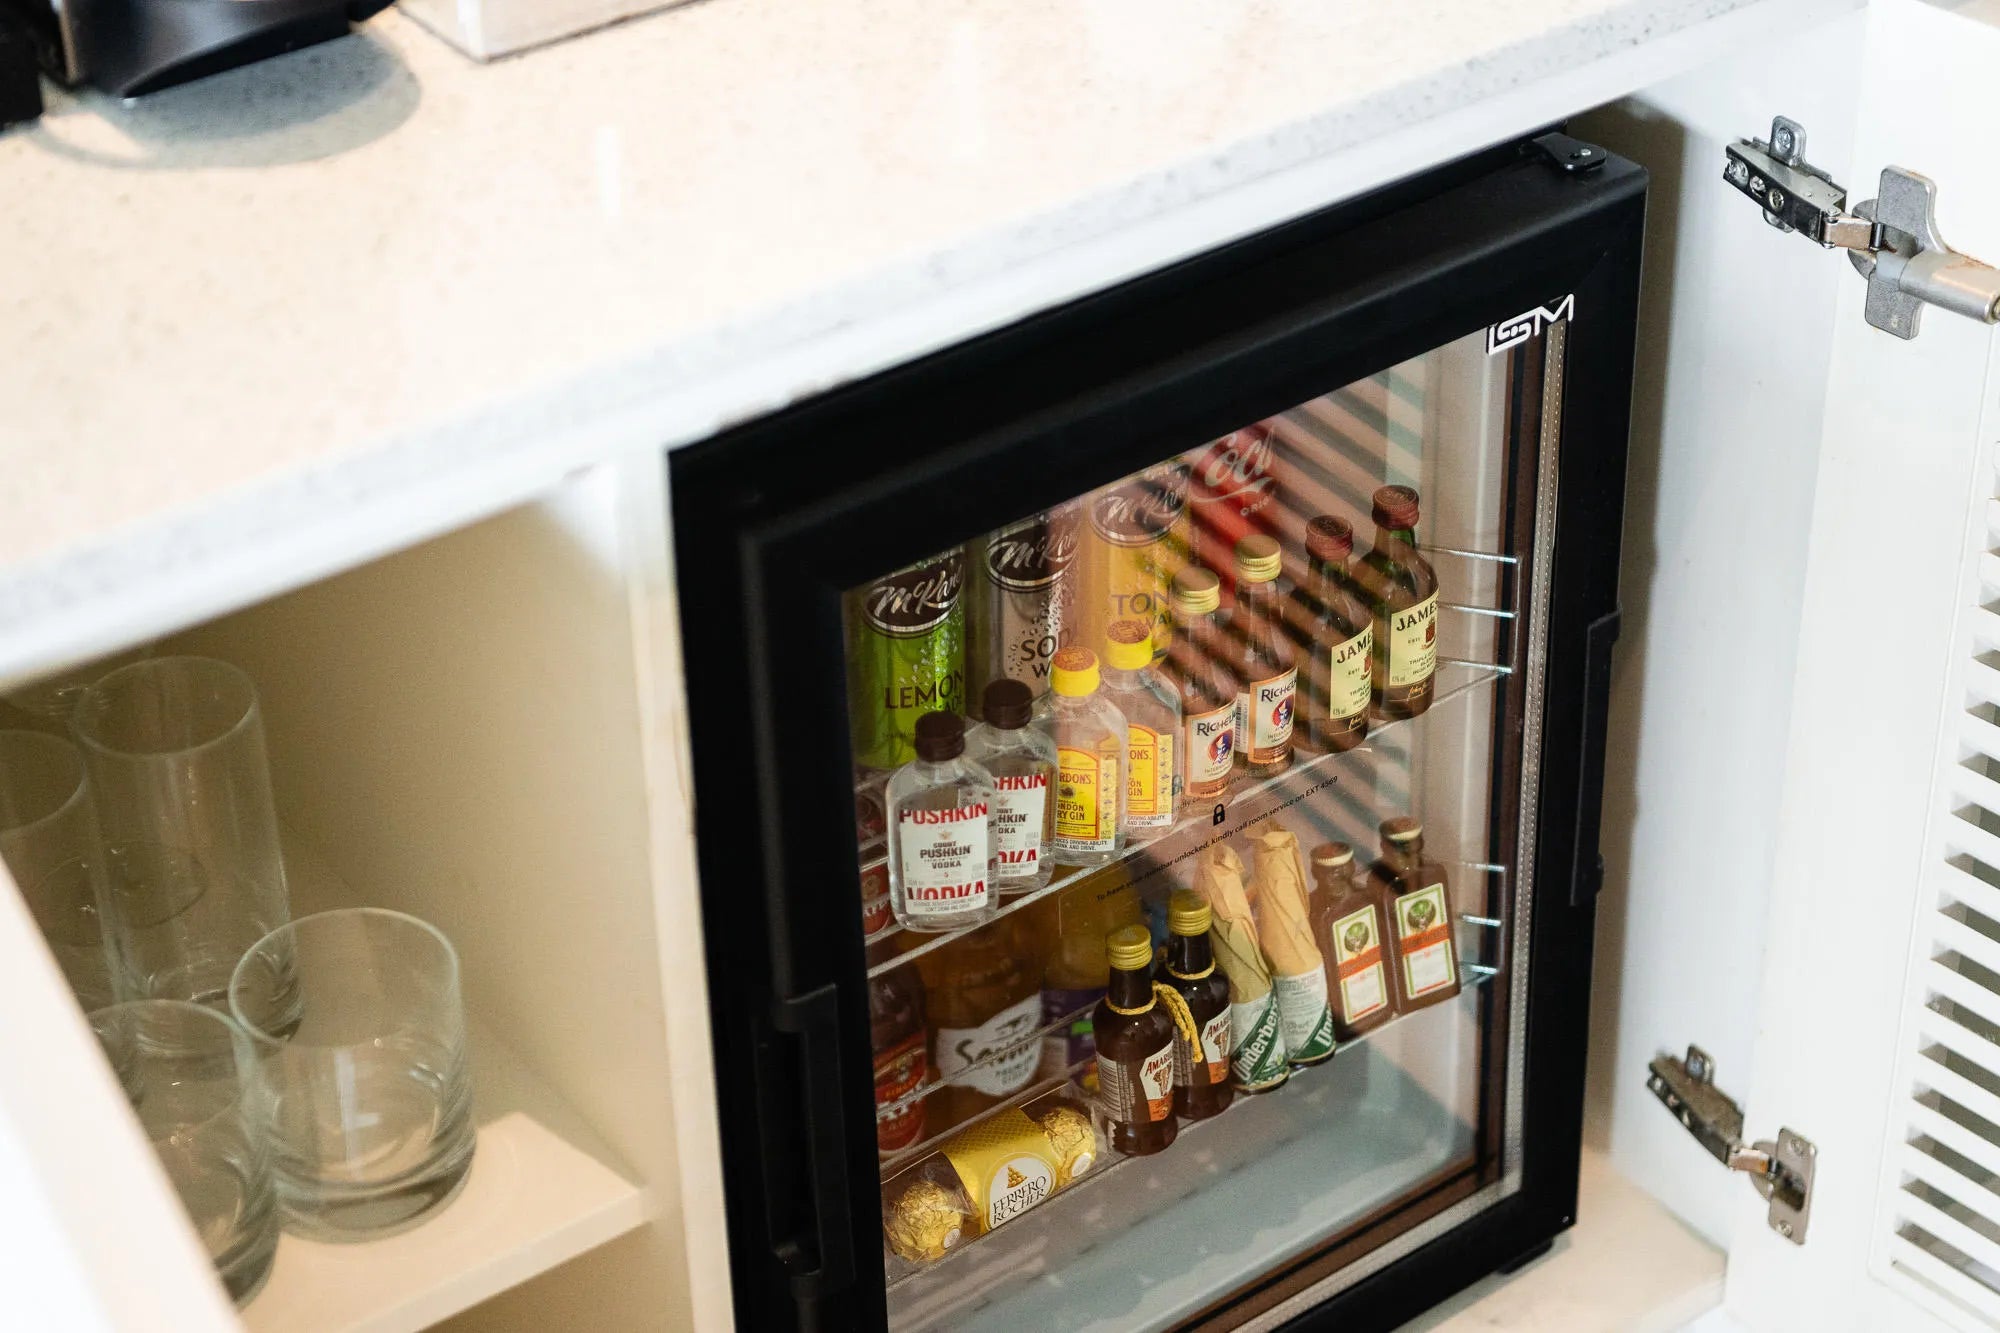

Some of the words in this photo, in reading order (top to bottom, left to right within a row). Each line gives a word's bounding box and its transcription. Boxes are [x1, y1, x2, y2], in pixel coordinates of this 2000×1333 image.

[1111, 591, 1170, 616] TON
[1336, 630, 1373, 664] JAME
[1269, 800, 1294, 816] service
[1295, 793, 1305, 802] on
[1305, 784, 1320, 797] EXT
[900, 802, 988, 825] PUSHKIN
[1069, 810, 1085, 821] GIN
[920, 845, 971, 859] PUSHKIN
[931, 860, 962, 869] VODKA
[906, 879, 985, 901] VODKA
[992, 1174, 1047, 1214] FERRERO
[992, 1187, 1046, 1224] ROCHER
